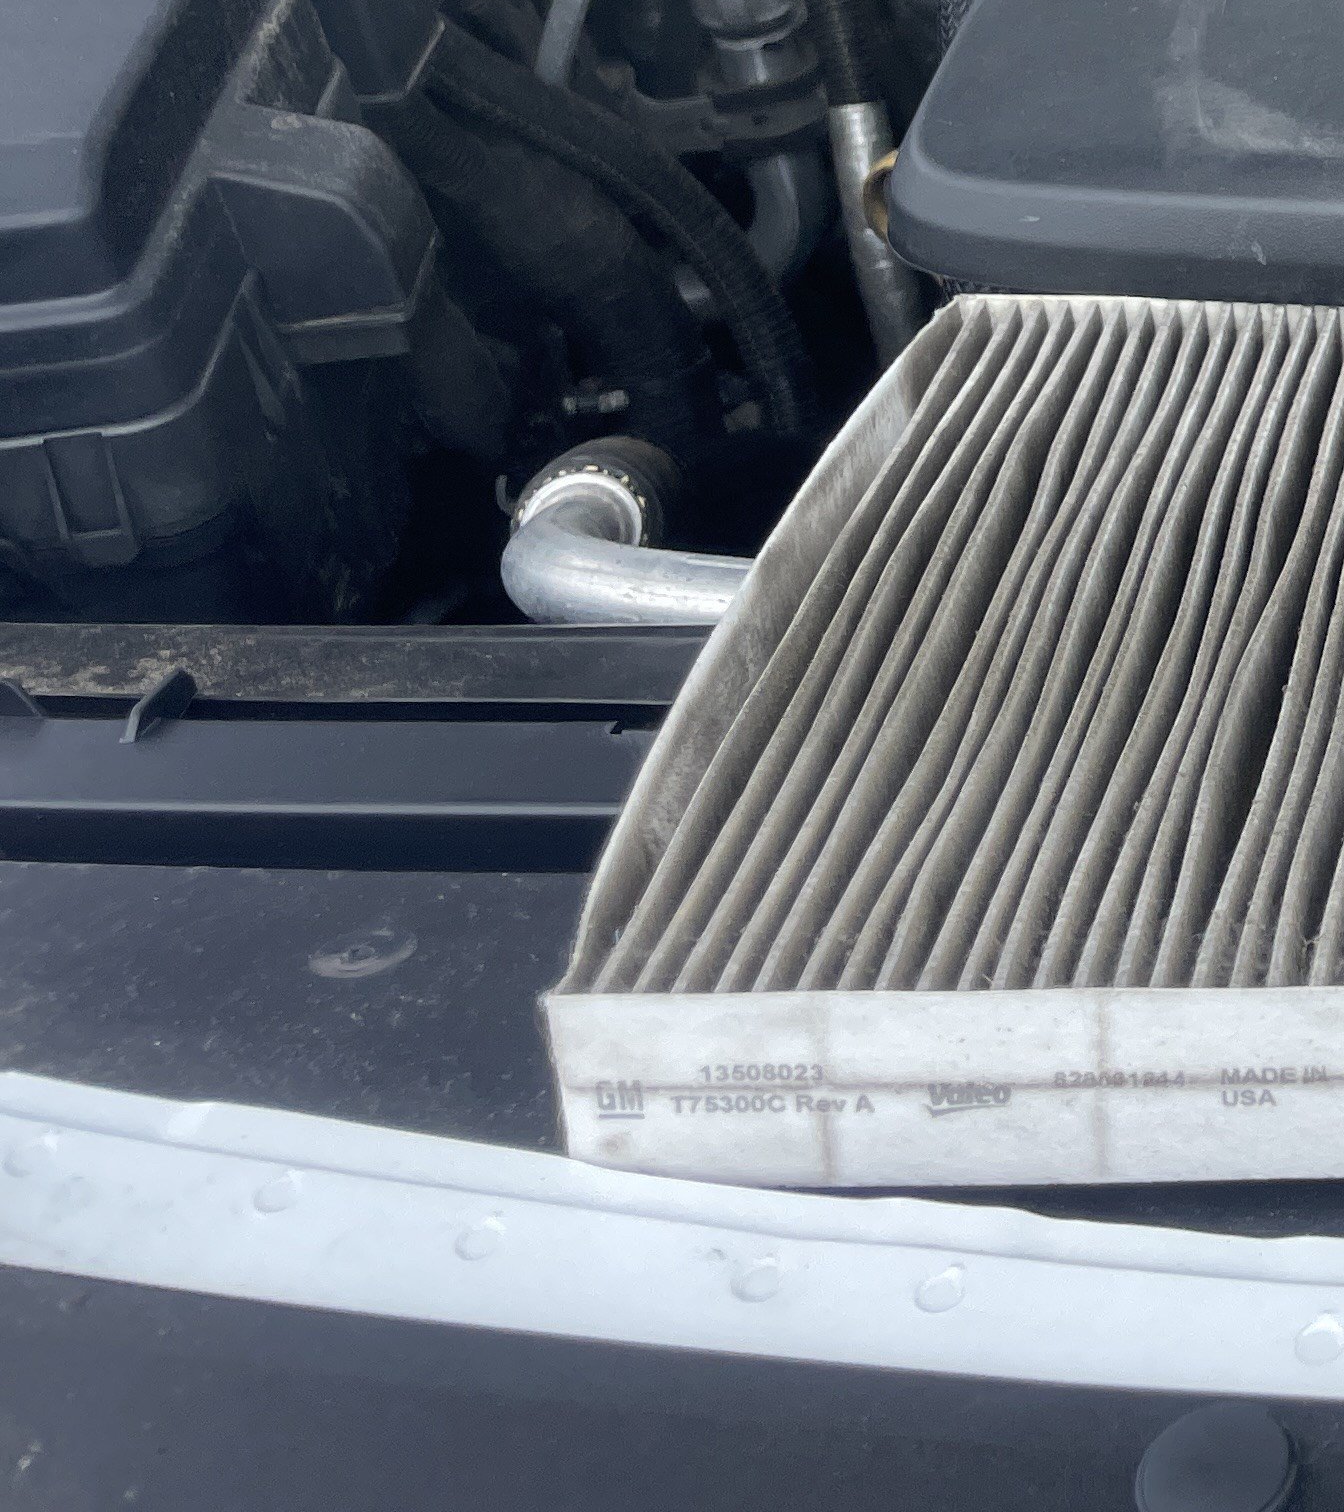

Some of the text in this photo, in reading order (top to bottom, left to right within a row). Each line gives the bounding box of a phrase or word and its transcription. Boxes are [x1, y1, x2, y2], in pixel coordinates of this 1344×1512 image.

[700, 1064, 824, 1082] 13508023
[1220, 1065, 1328, 1085] MADE IN
[595, 1080, 643, 1112] GM
[671, 1094, 876, 1114] T75300C Rev A
[1221, 1089, 1276, 1107] USA
